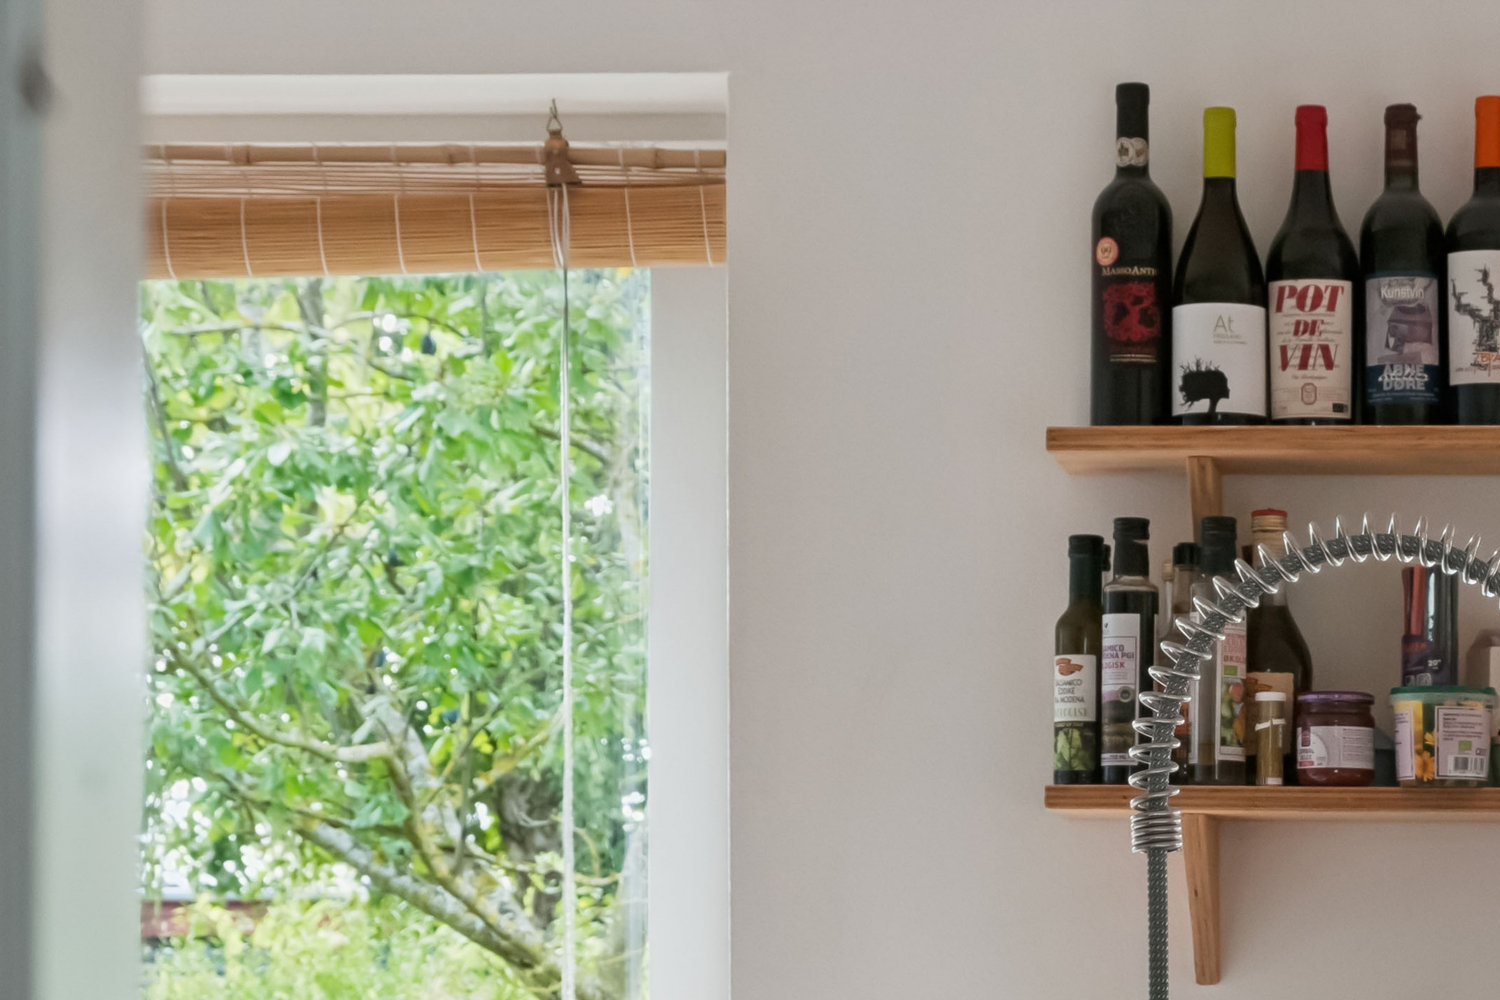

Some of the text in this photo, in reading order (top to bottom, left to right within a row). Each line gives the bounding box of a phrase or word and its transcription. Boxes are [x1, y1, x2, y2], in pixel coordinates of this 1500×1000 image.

[1275, 284, 1345, 313] POT
[1213, 314, 1234, 333] At
[1293, 319, 1325, 337] DE
[1278, 344, 1339, 372] VIN
